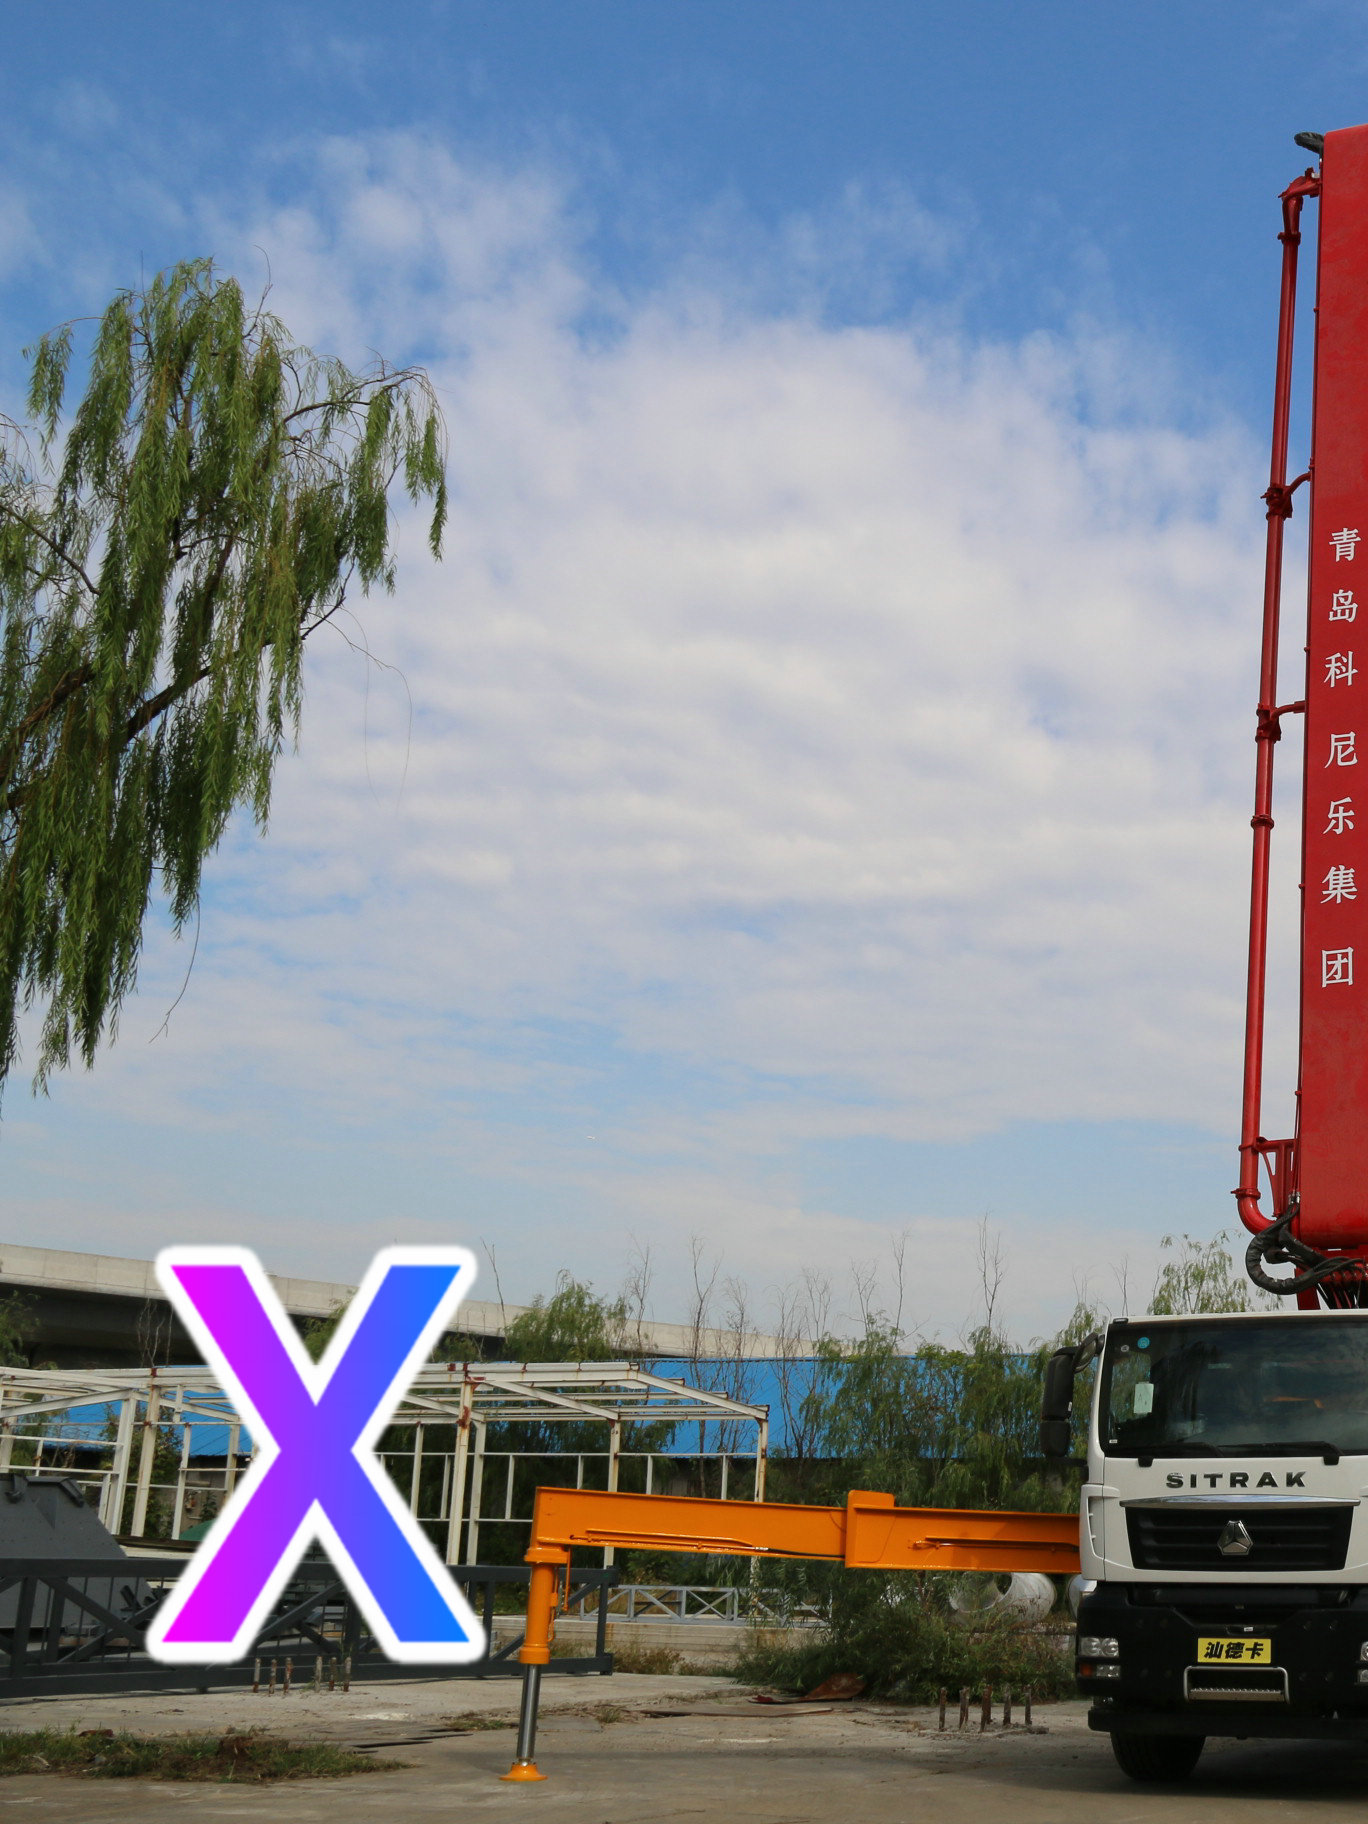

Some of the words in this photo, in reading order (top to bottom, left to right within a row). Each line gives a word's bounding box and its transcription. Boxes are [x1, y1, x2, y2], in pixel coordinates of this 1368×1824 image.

[1320, 526, 1362, 989] 青岛科尼乐集团
[1165, 1471, 1307, 1489] SITRAK
[1203, 1641, 1264, 1660] 汕德卡
